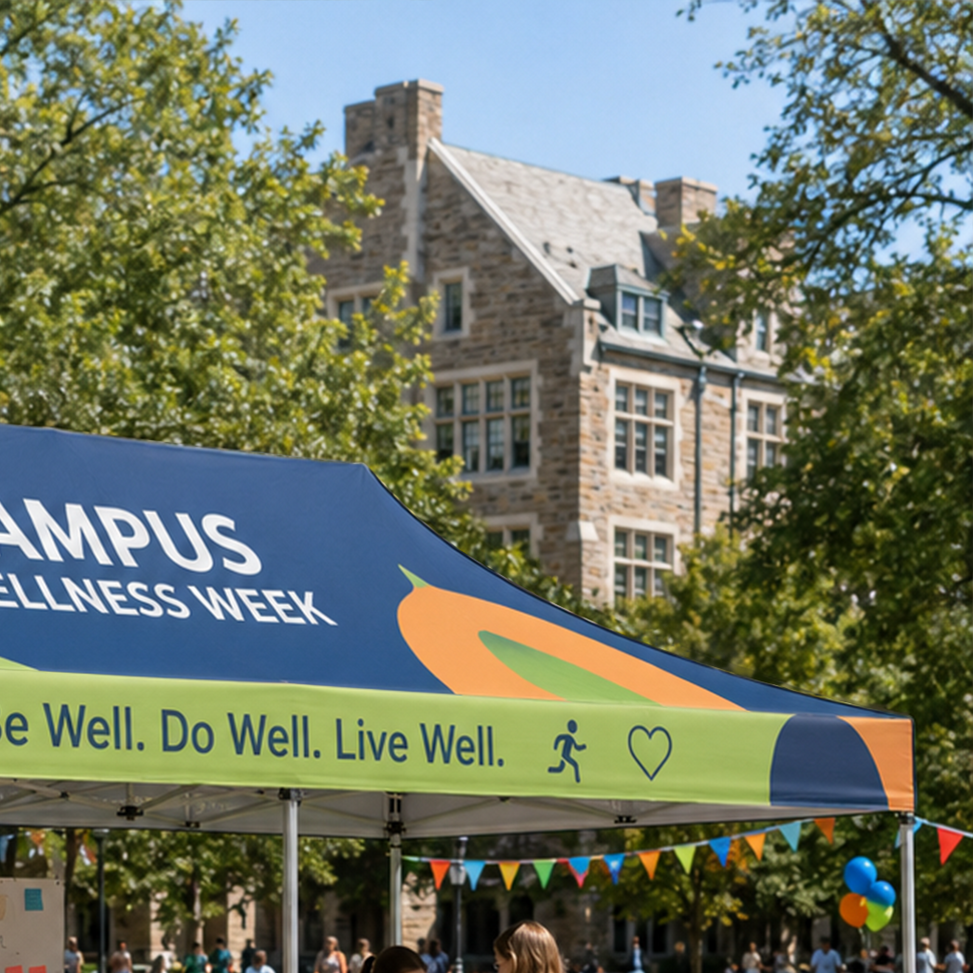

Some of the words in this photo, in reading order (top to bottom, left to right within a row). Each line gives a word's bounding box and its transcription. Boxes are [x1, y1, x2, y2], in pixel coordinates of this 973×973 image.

[188, 585, 339, 626] WEEK
[42, 702, 145, 752] Well.
[160, 708, 215, 754] Do
[226, 713, 321, 760] Well.
[335, 718, 409, 763] Live
[420, 723, 505, 768] Well.
